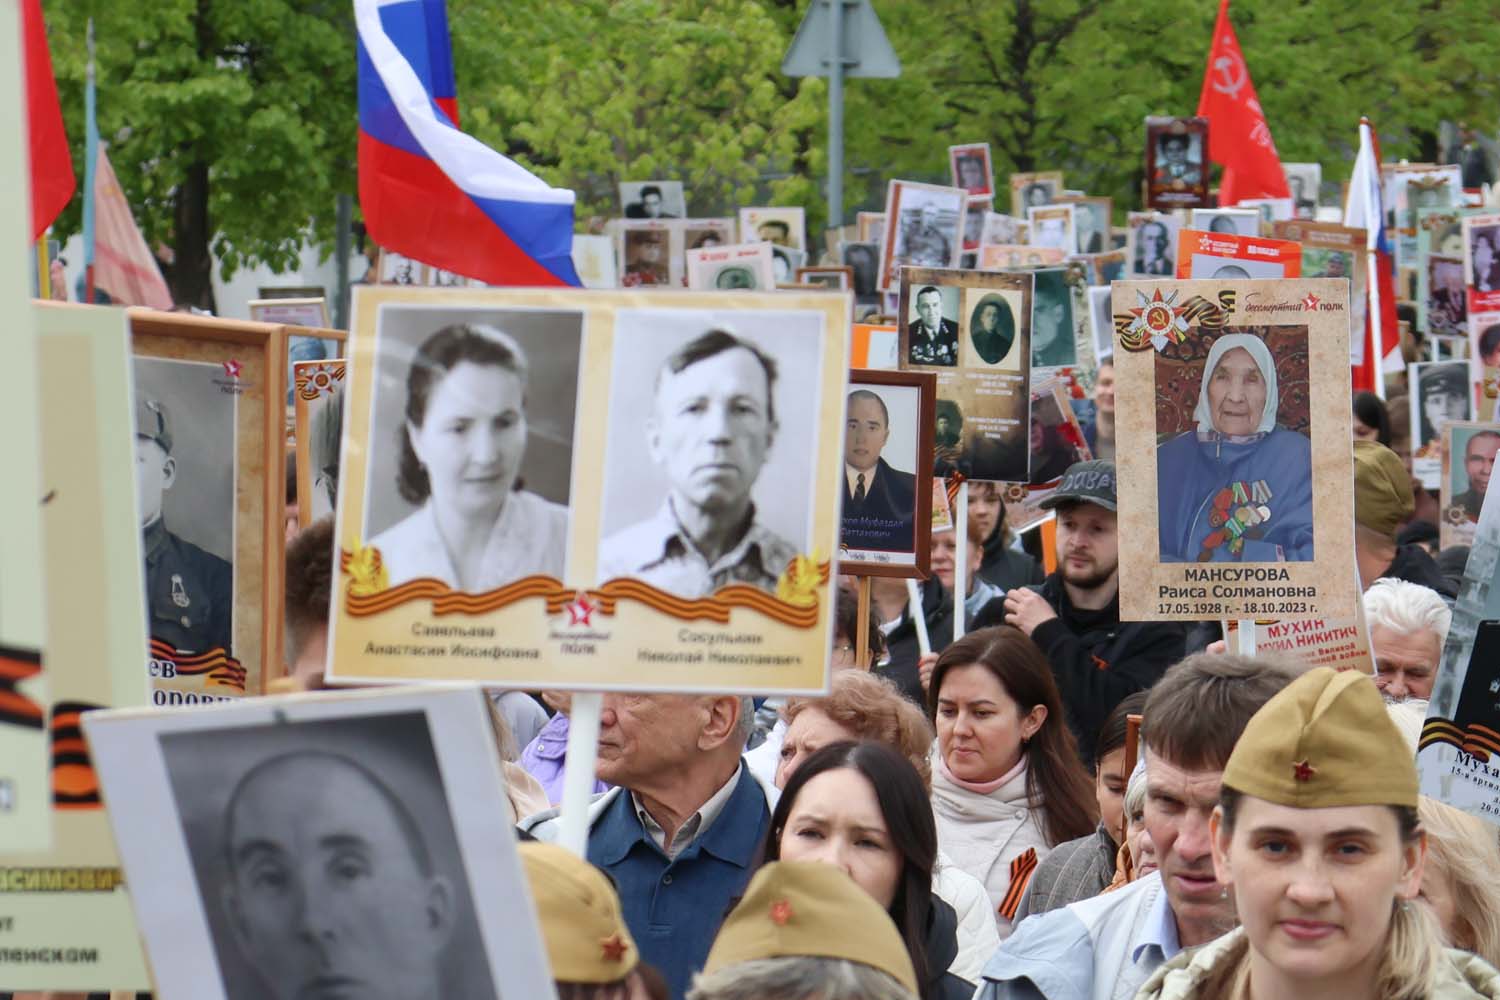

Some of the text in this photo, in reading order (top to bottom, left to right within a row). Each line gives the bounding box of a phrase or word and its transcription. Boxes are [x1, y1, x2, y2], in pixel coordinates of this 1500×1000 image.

[1184, 568, 1290, 582] МАНСУРОВА
[1159, 585, 1316, 598] Раиса Солмановна
[1158, 603, 1222, 614] 17.05.1928
[1225, 606, 1233, 614] г.
[1244, 603, 1307, 614] 18.10.2023
[1310, 605, 1318, 613] г.
[1268, 619, 1325, 639] МУХИН
[1256, 626, 1358, 652] МУИЛ НИКИТИЧ
[364, 642, 446, 657] Анастасия
[150, 660, 175, 678] ев
